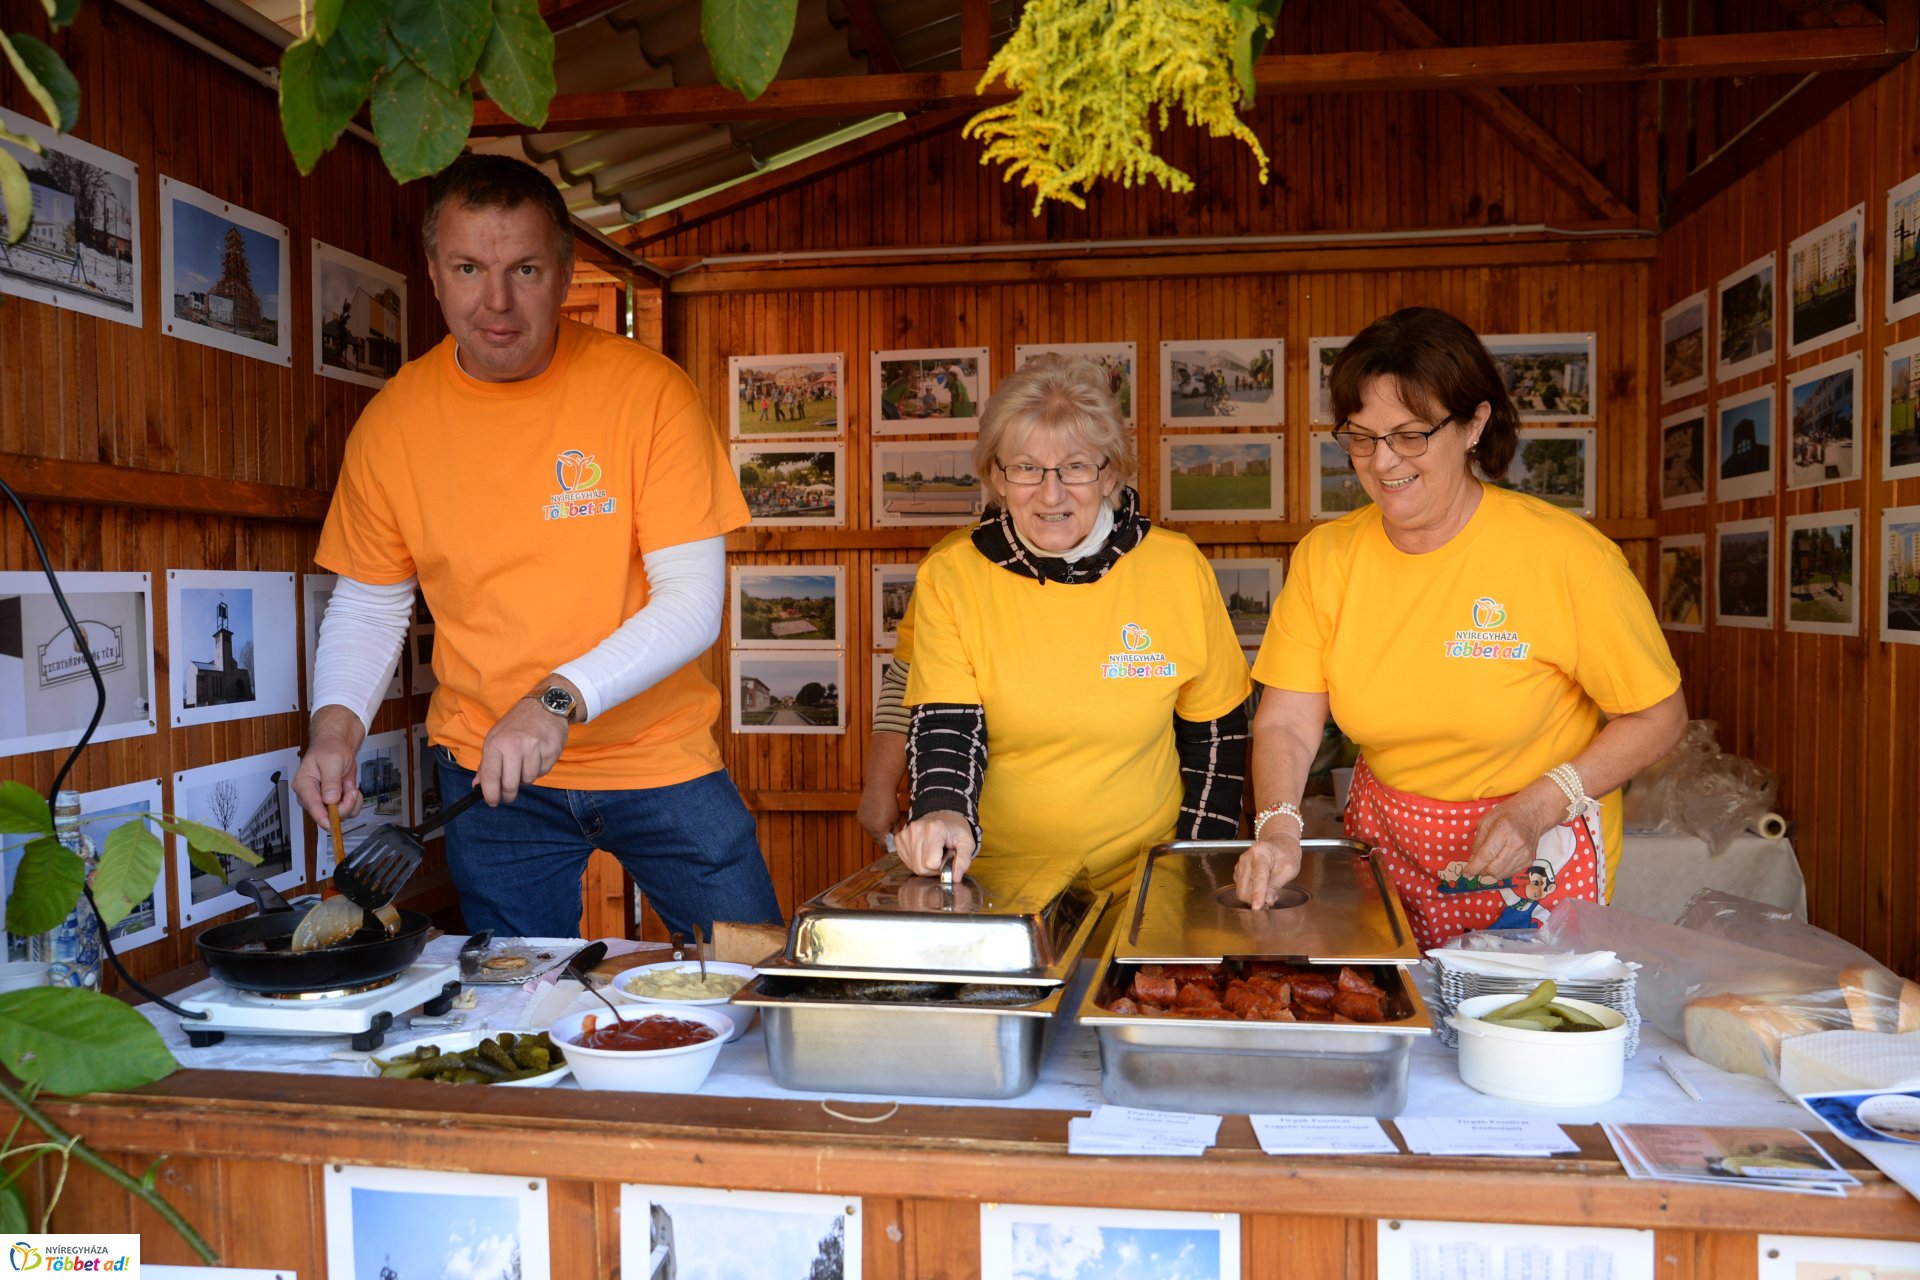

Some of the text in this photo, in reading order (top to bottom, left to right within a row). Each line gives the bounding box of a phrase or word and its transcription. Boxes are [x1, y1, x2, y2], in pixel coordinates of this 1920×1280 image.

[551, 490, 606, 502] NYÍREGYHÁZA
[542, 498, 616, 520] Többet ad!
[1456, 630, 1518, 641] NYÍREGYHÁZA
[1445, 641, 1530, 659] Többet ad!
[1108, 653, 1166, 662] NYÍREGYHÁZA
[1101, 662, 1177, 678] Többet ad!
